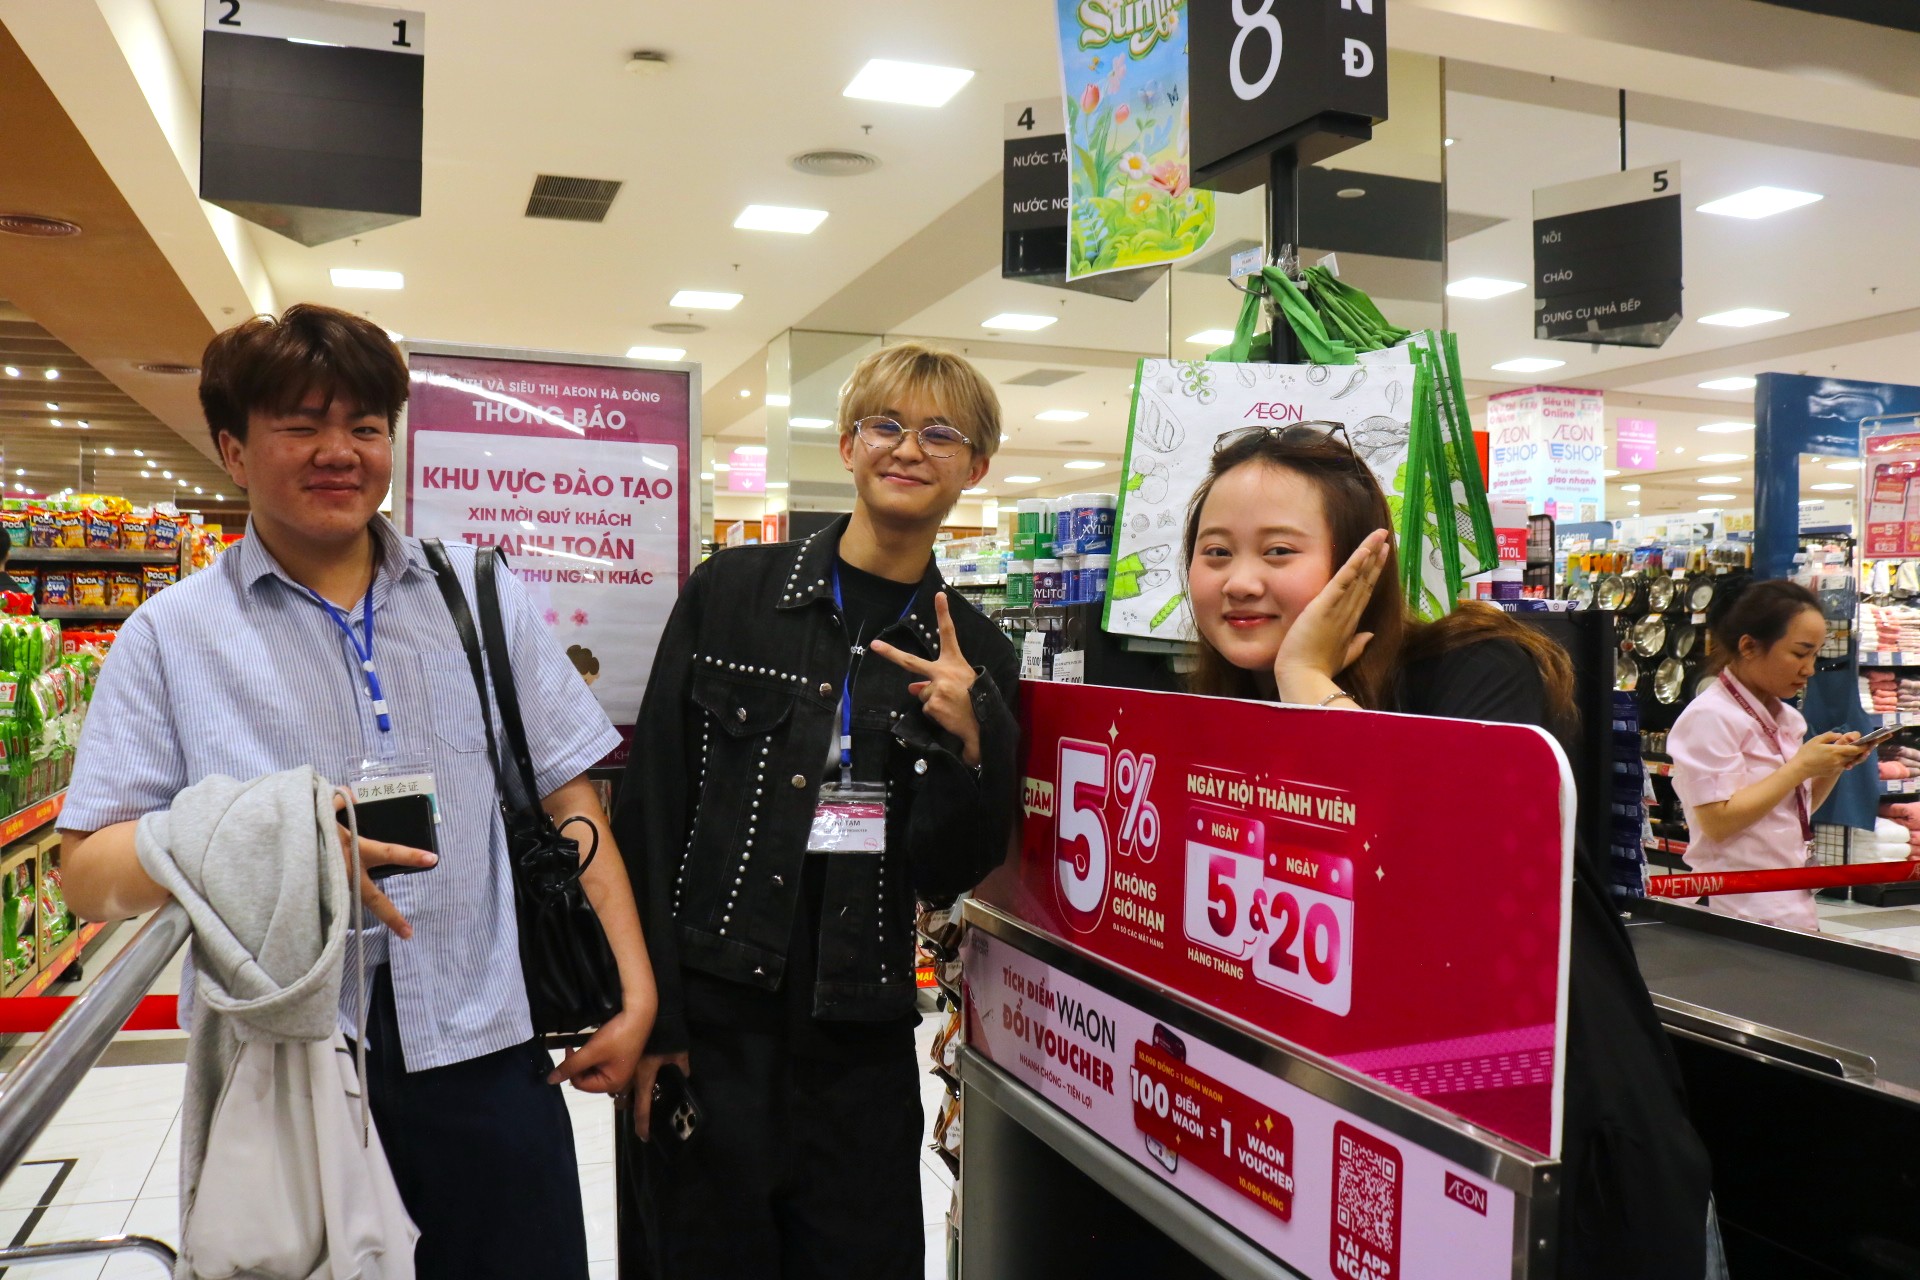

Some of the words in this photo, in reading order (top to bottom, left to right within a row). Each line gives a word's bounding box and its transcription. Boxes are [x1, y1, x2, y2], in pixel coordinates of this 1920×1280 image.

[218, 0, 241, 26] 2
[392, 19, 411, 47] 1
[1229, 0, 1282, 100] 8
[1342, 38, 1374, 78] Đ
[1017, 107, 1035, 130] 4
[1013, 151, 1049, 167] NƯỚC
[1653, 170, 1668, 192] 5
[1013, 197, 1048, 213] NƯỚC
[1542, 310, 1572, 324] DỤNG
[1576, 307, 1591, 319] CỤ
[488, 378, 505, 391] VÀ
[509, 380, 535, 394] SIÊU
[539, 384, 559, 399] THỊ
[562, 386, 597, 398] AEON
[601, 386, 617, 400] HÀ
[622, 388, 660, 402] ĐÔNG
[573, 404, 626, 430] BÁO
[1543, 408, 1575, 418] Online
[422, 466, 479, 491] KHU
[487, 468, 546, 499] VỰC
[553, 468, 614, 498] ĐÀO
[620, 476, 673, 504] TẠO
[1568, 476, 1596, 485] nhanh
[468, 507, 496, 521] XIN
[501, 506, 533, 522] MỜI
[537, 508, 570, 524] QUÝ
[575, 509, 632, 527] KHÁCH
[561, 531, 634, 560] TOÁN
[1498, 547, 1520, 558] ITOL
[148, 571, 168, 579] POCA
[523, 569, 552, 583] THU
[556, 568, 604, 584] NGÂN
[608, 568, 653, 585] KHÁC
[358, 781, 419, 798] 防水展会证
[1023, 780, 1051, 812] GIẢM
[1187, 773, 1225, 799] NGÀY
[1228, 780, 1254, 809] HỘI
[1257, 786, 1312, 817] THÀNH
[1316, 796, 1356, 826] VIÊN
[1057, 746, 1158, 914] 5%
[1211, 822, 1239, 842] NGÀY
[1286, 856, 1319, 879] NGÀY
[1114, 870, 1157, 901] KHÔNG
[1656, 876, 1724, 897] VIETNAM
[1112, 896, 1137, 918] GIỚI
[1138, 907, 1165, 933] HẠN
[1207, 853, 1237, 938] 5
[1249, 888, 1269, 934] &
[1268, 891, 1341, 985] 20
[916, 971, 933, 983] MẠI
[1187, 946, 1212, 968] HÀNG
[1213, 954, 1244, 980] THÁNG
[1003, 965, 1025, 995] TÍCH
[1027, 977, 1055, 1012] ĐIỂM
[1057, 991, 1116, 1053] WAON
[1003, 998, 1030, 1043] ĐỔI
[1033, 1021, 1115, 1096] VOUCHER
[1019, 1053, 1040, 1075] NHANH
[1040, 1065, 1062, 1089] CHÓNG
[1066, 1082, 1081, 1101] TIỆN
[1081, 1093, 1093, 1109] LỢI
[1130, 1066, 1170, 1119] 100
[1184, 1073, 1201, 1091] ĐIỂM
[1201, 1084, 1223, 1103] WAON
[1175, 1093, 1201, 1119] ĐIỂM
[1172, 1108, 1204, 1140] WAON
[1220, 1118, 1232, 1158] 1
[1247, 1133, 1285, 1168] WAON
[1238, 1147, 1294, 1193] VOUCHER
[1239, 1176, 1261, 1197] 10.000
[1262, 1190, 1284, 1212] ĐỒNG
[1338, 1233, 1360, 1260] TẢI
[1362, 1250, 1391, 1276] APP
